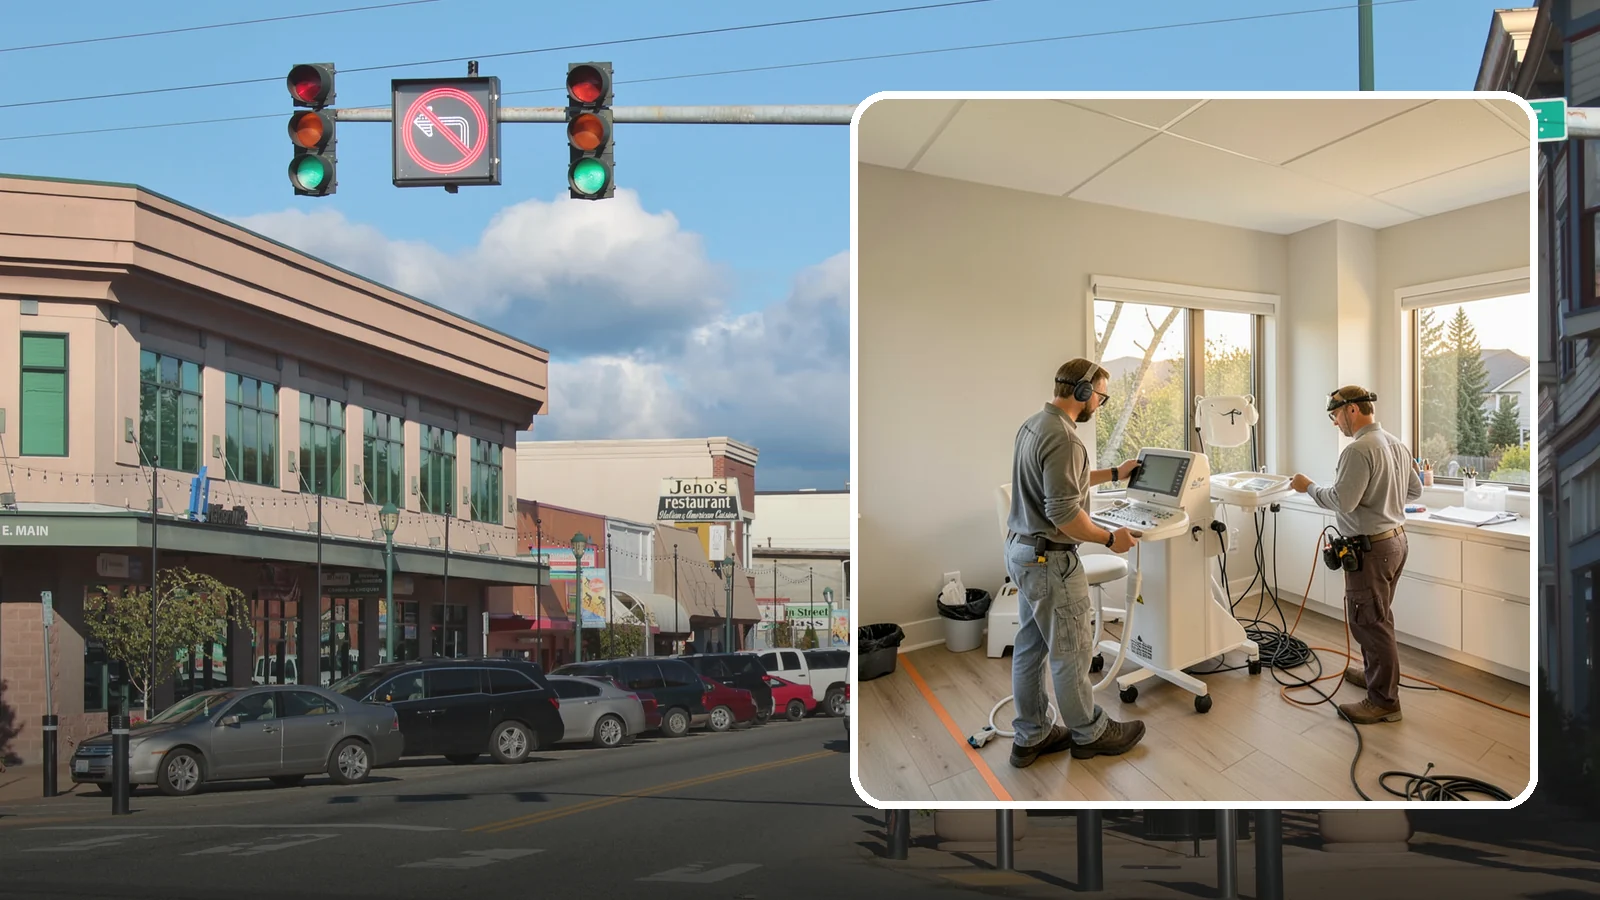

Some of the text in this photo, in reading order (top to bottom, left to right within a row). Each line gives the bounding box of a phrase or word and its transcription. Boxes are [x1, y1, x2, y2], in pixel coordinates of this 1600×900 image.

[669, 480, 728, 494] Jeno's
[665, 496, 731, 509] restaurant
[658, 510, 681, 520] Italian
[686, 509, 714, 519] American
[715, 509, 737, 519] Cuisine
[2, 525, 49, 536] E. MAIN
[797, 607, 828, 617] Street
